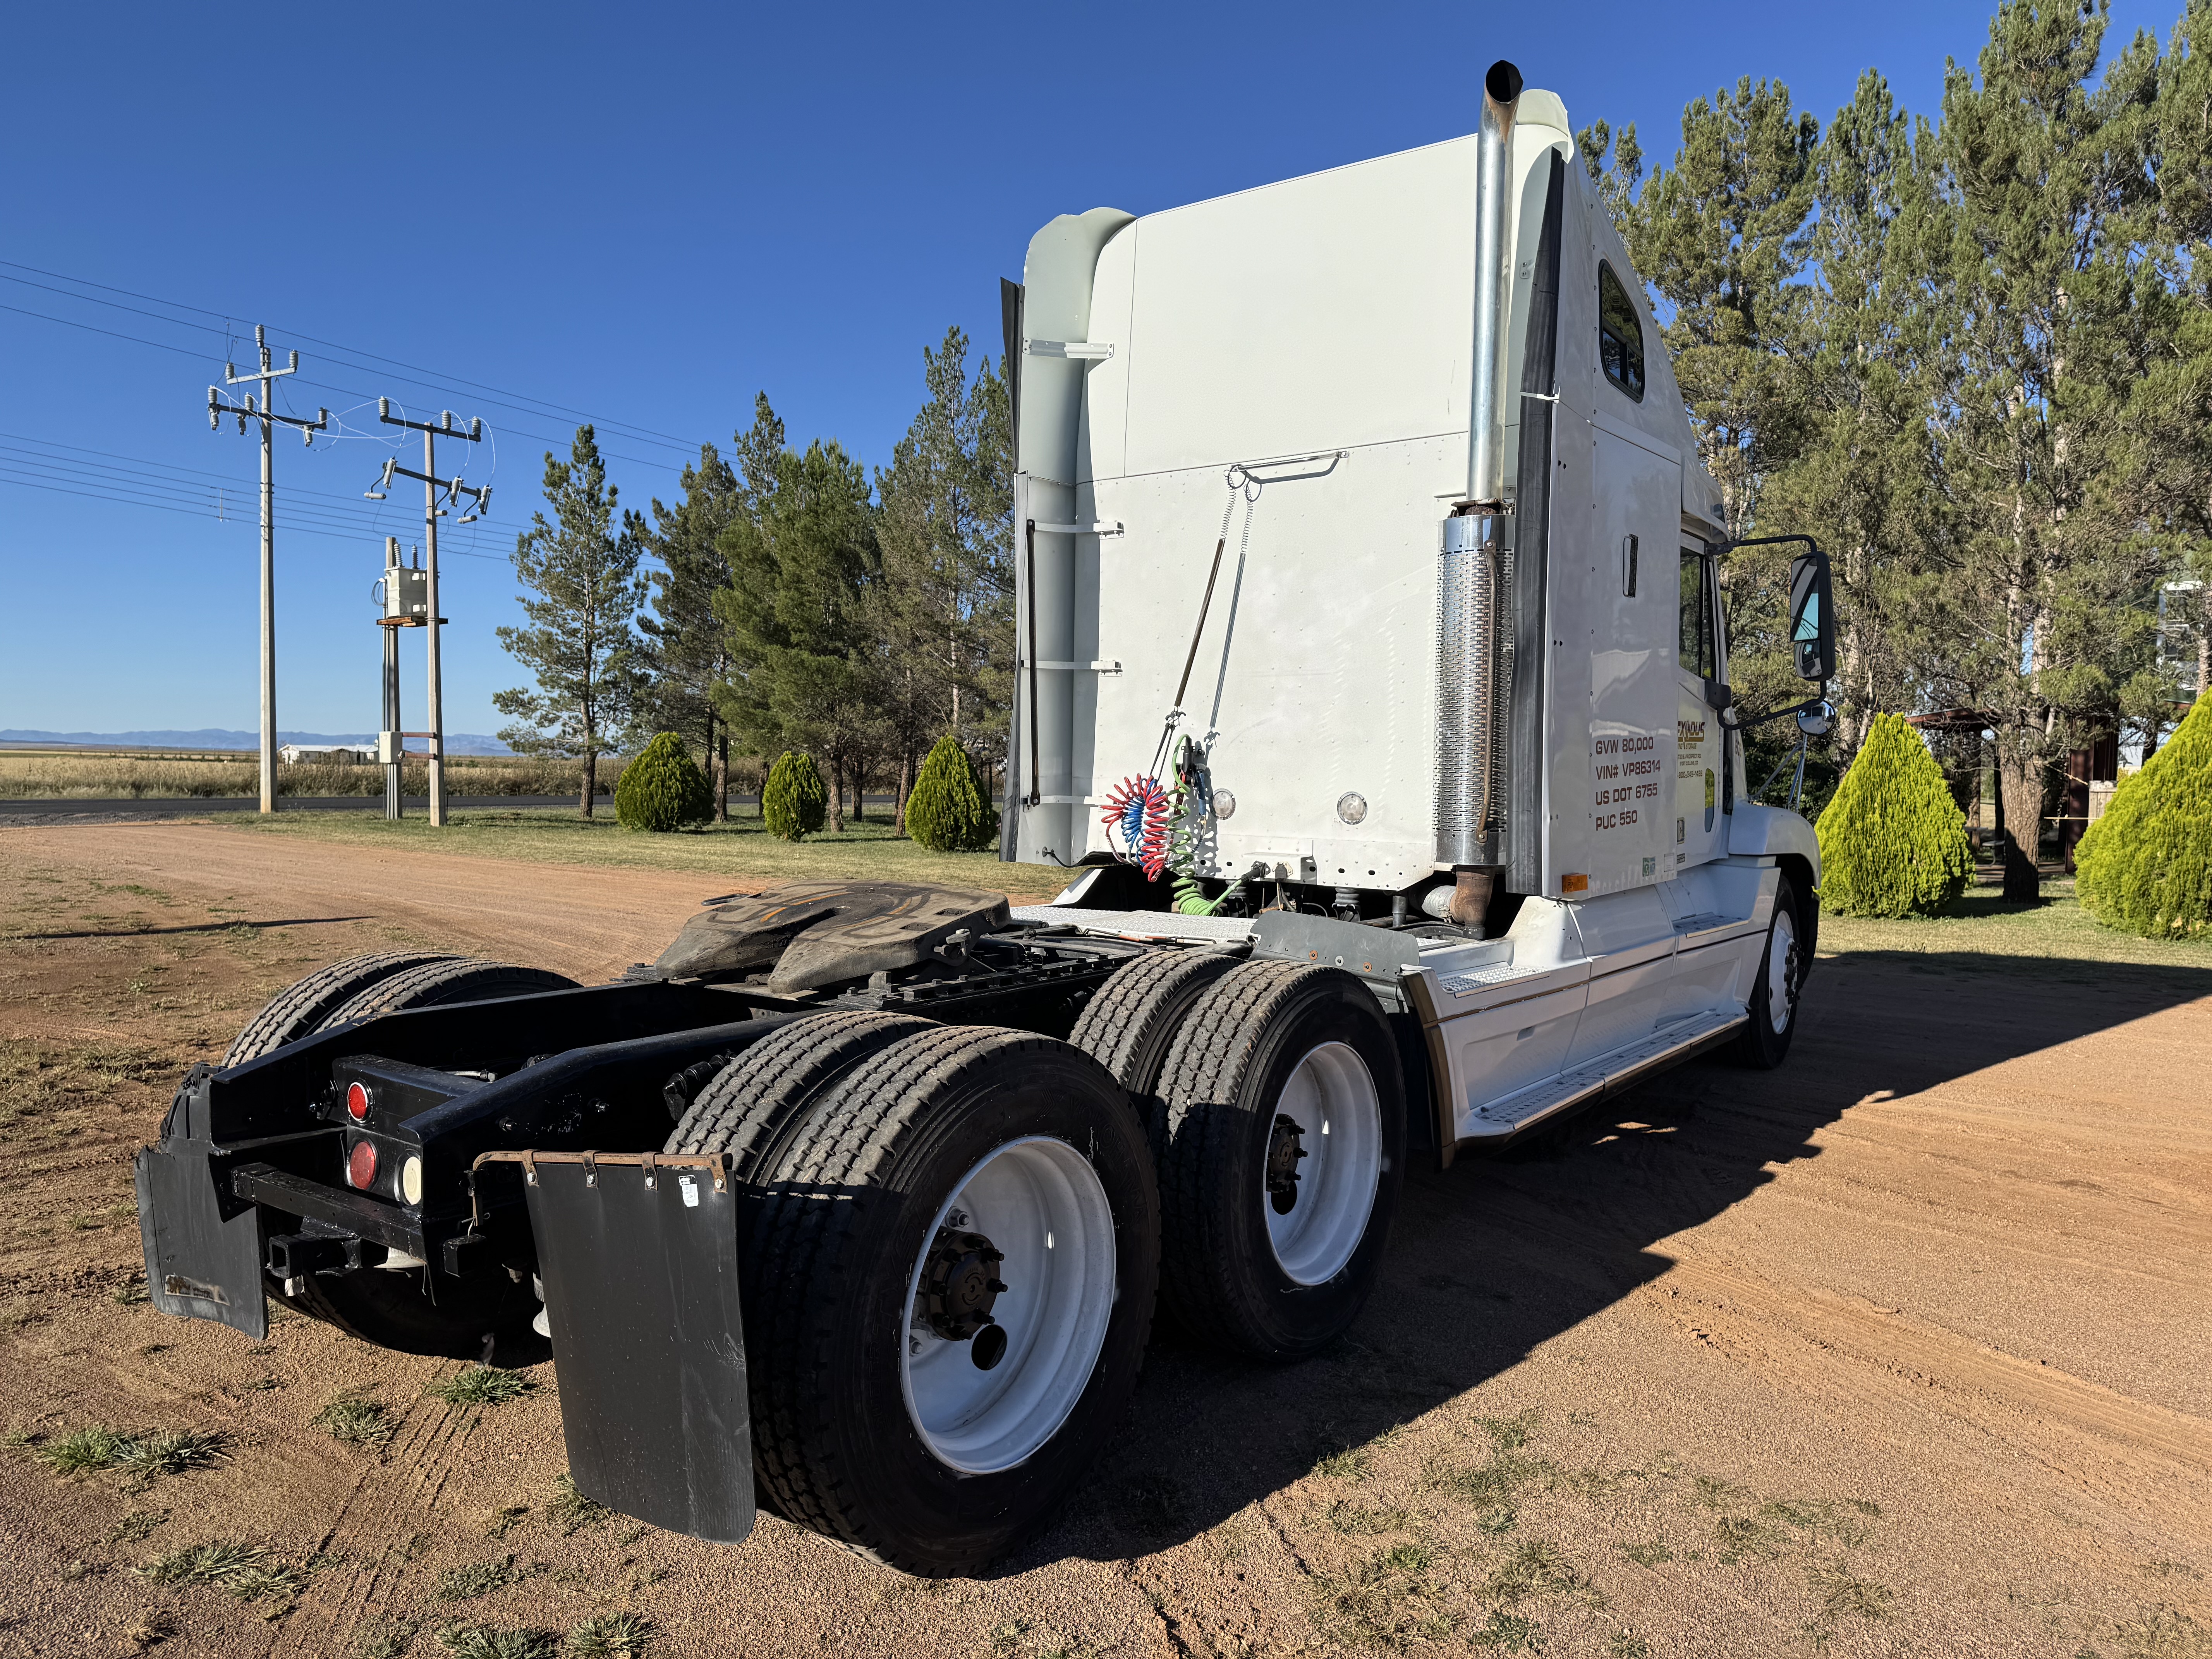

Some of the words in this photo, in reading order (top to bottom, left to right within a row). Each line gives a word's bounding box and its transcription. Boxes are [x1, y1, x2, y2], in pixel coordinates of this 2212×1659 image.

[1596, 739, 1618, 754] GVW
[1622, 737, 1653, 754] 80,000
[1596, 764, 1618, 780] VIN#
[1622, 759, 1660, 776] VP86314
[1596, 790, 1609, 805] US
[1613, 787, 1632, 803] DOT
[1636, 783, 1657, 799] 6755
[1596, 814, 1616, 831] PUC
[1620, 810, 1637, 826] 550
[1070, 1095, 1147, 1228] YOKOHAMA
